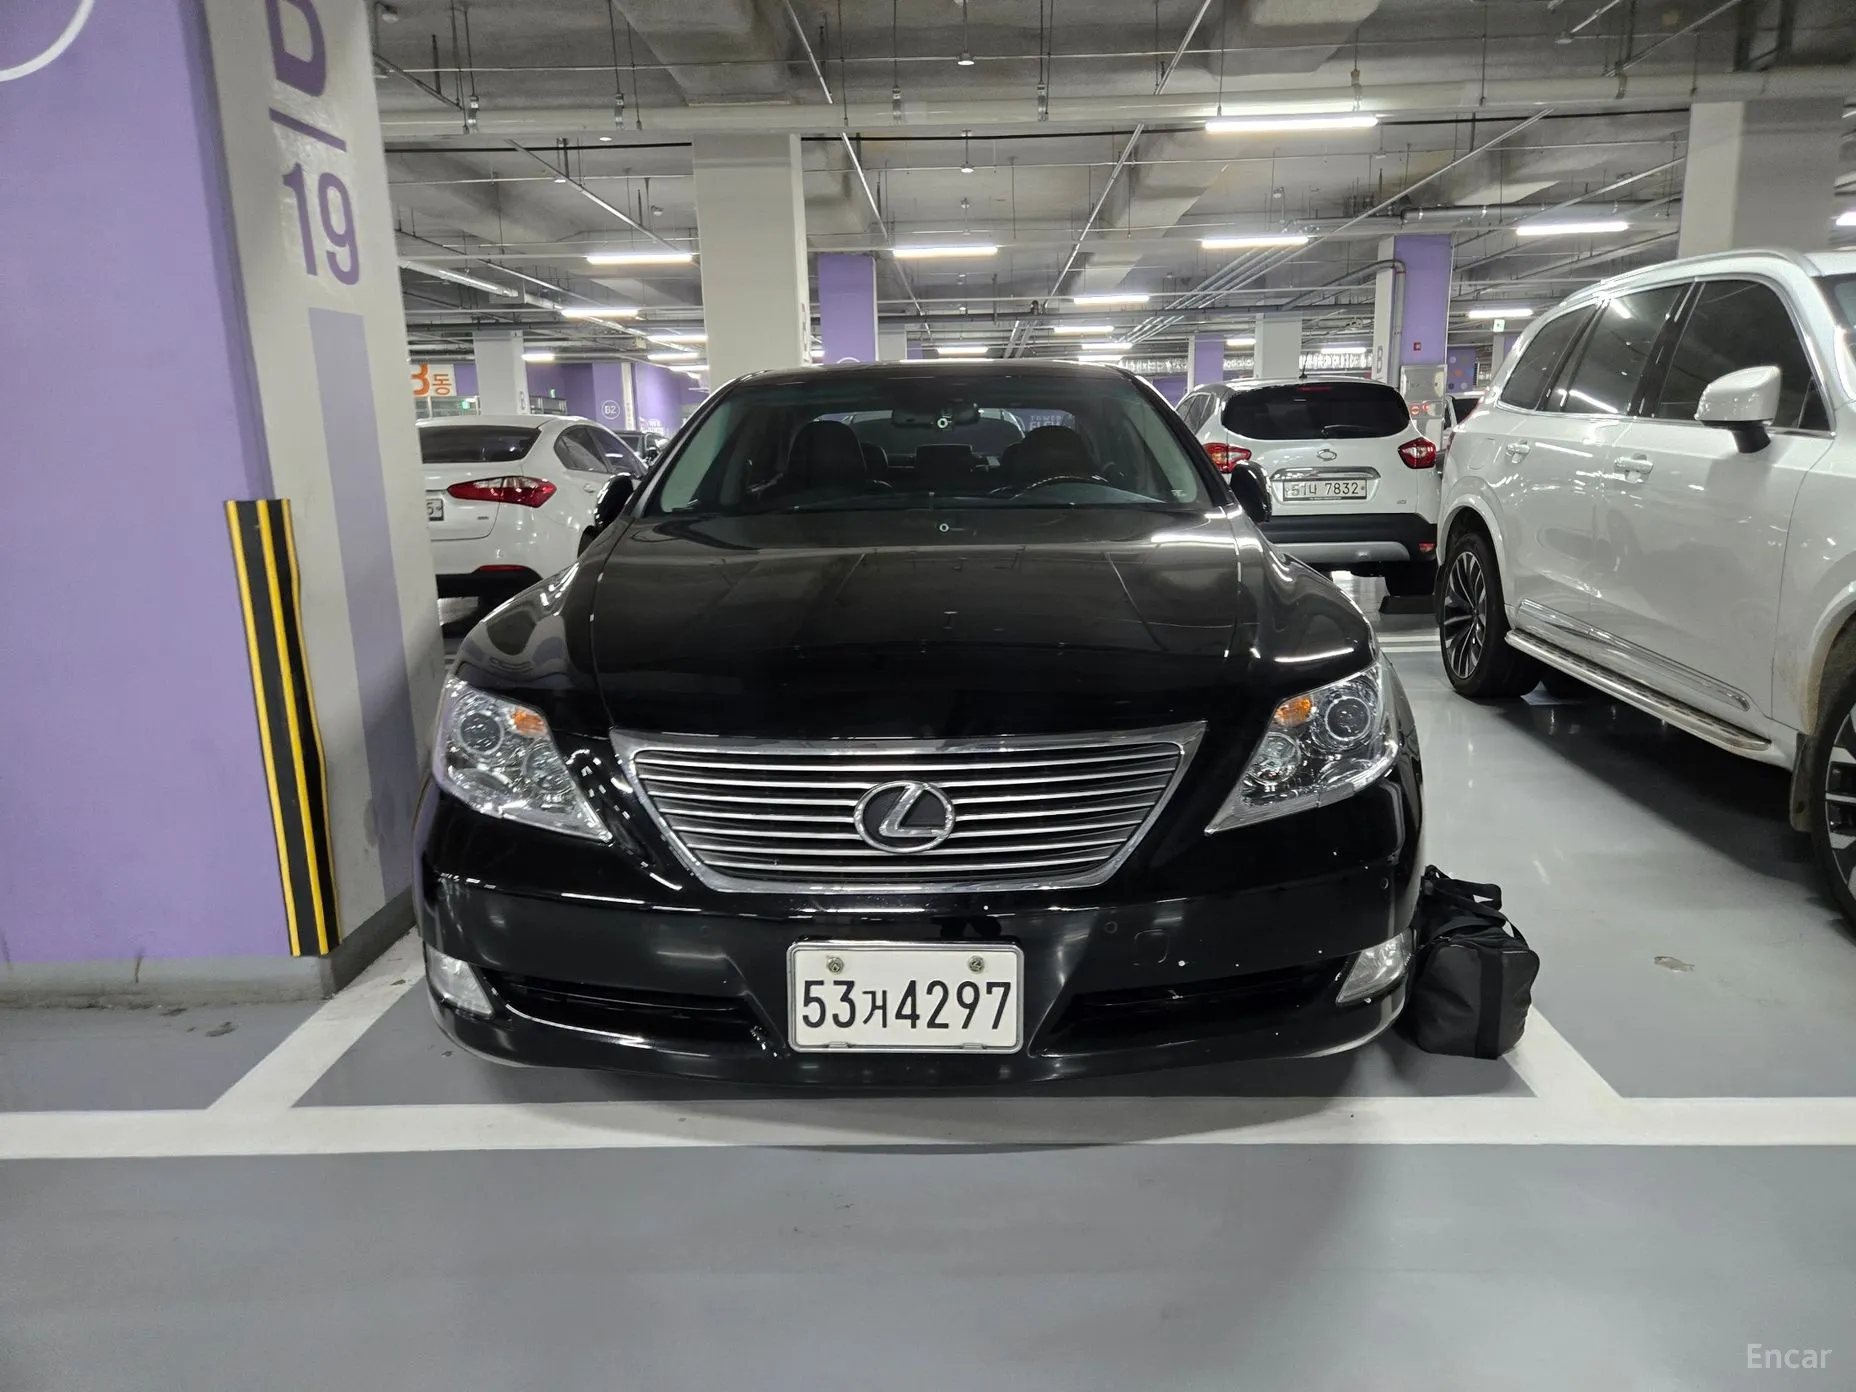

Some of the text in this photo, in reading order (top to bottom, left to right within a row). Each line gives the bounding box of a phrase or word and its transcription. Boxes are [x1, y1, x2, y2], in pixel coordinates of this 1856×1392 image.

[282, 162, 360, 286] 19
[1325, 481, 1359, 495] 7832
[802, 979, 1012, 1030] 53거4297
